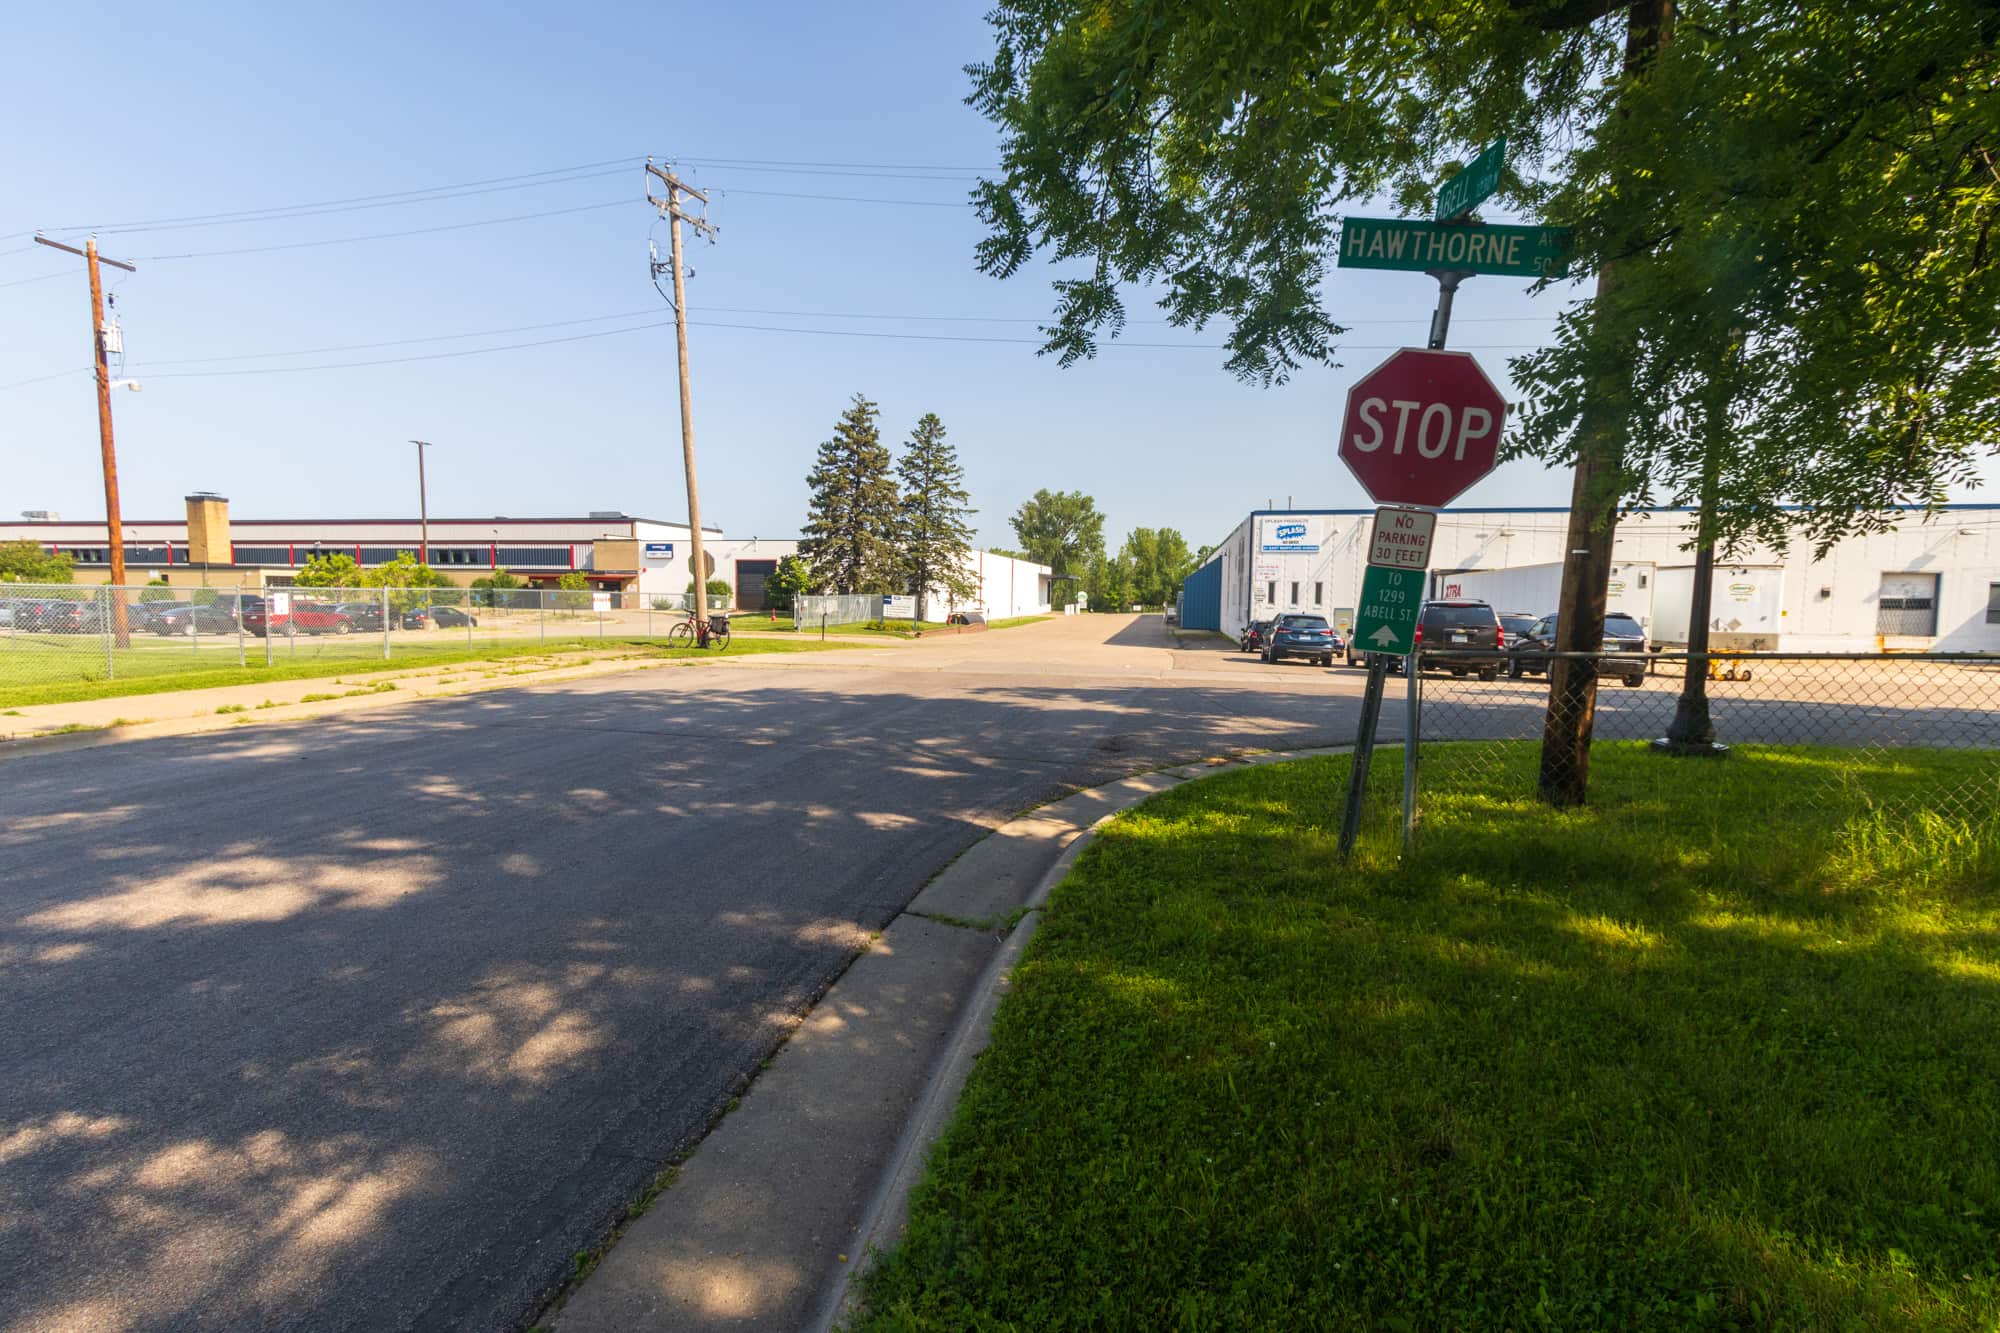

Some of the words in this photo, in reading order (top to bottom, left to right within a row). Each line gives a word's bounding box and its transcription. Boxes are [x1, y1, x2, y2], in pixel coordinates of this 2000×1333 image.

[1437, 175, 1469, 219] ABELL
[1347, 227, 1526, 266] HAWTHORNE
[1353, 397, 1492, 461] STOP
[1395, 516, 1414, 528] NO
[1279, 526, 1305, 538] SPLASH
[1378, 531, 1426, 547] PARKING
[1375, 547, 1391, 559] 30
[1395, 549, 1423, 562] FEET
[1388, 572, 1402, 586] TO
[1379, 588, 1405, 603] 1299
[1363, 605, 1394, 619] ABELL
